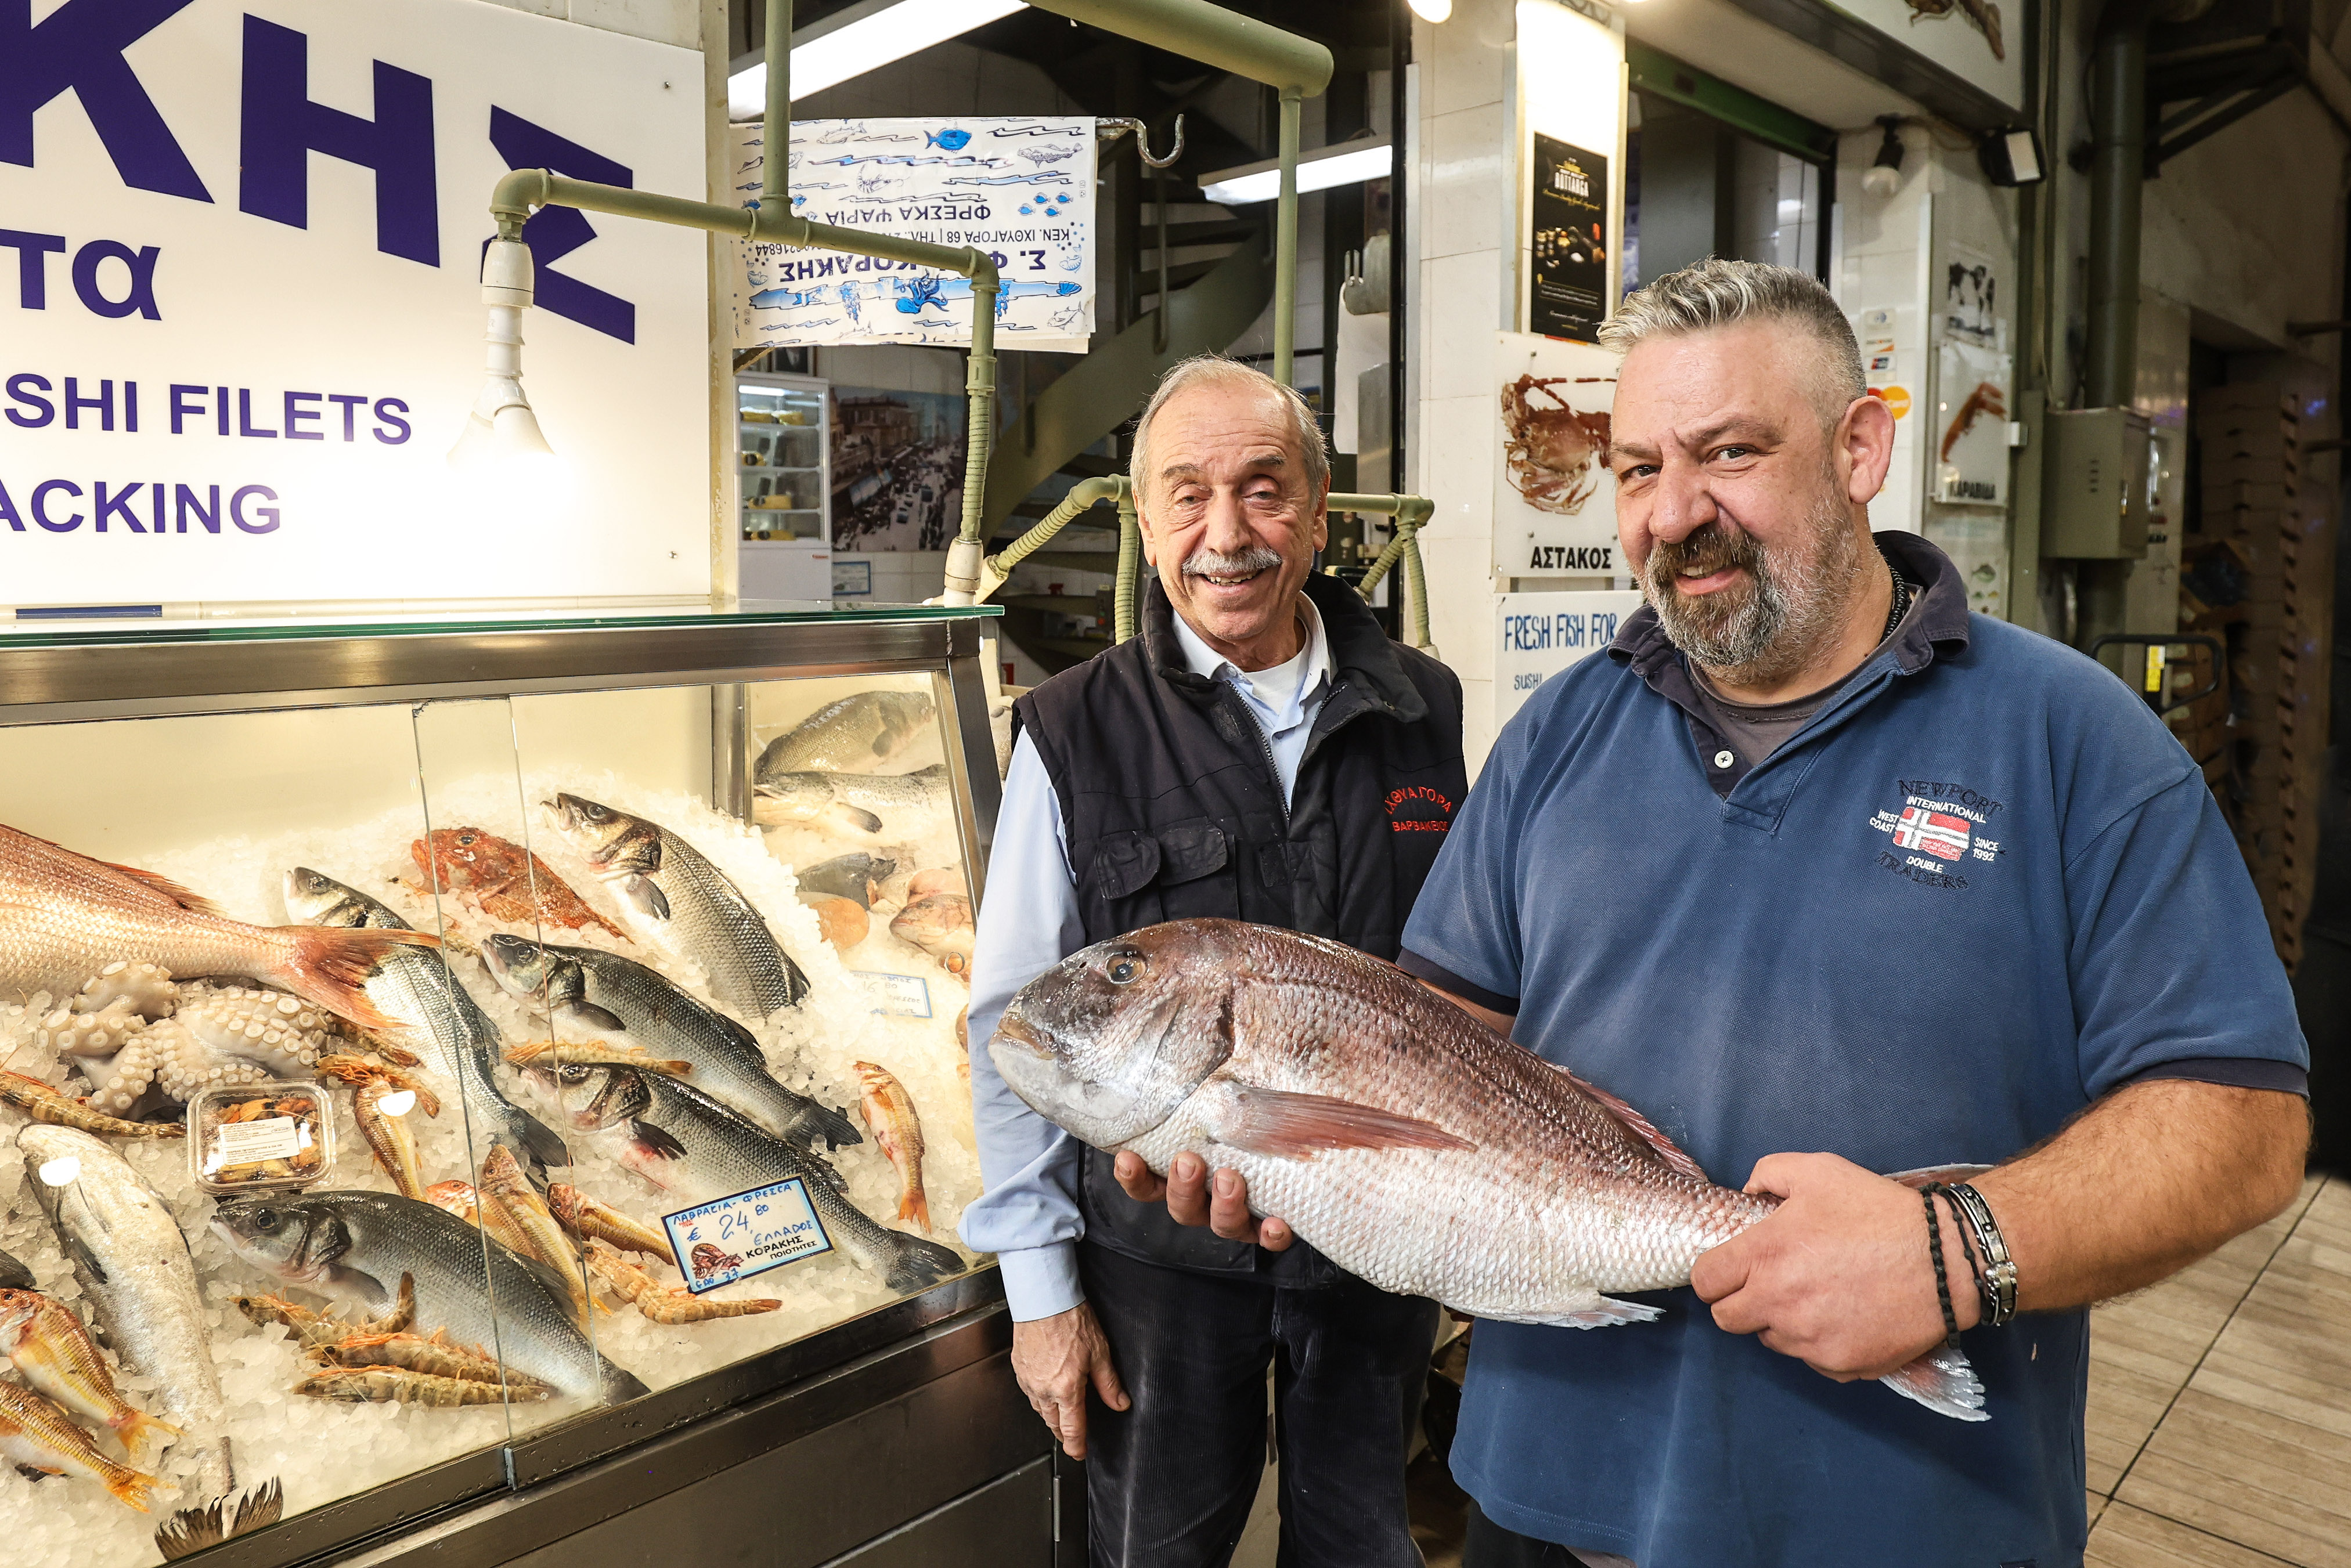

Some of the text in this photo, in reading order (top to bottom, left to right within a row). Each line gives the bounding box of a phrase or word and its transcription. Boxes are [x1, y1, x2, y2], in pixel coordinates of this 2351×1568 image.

[825, 204, 991, 226] ΦΡΕΣΚΑ ΨΑΡΙΑ
[947, 231, 961, 243] 68
[964, 229, 1036, 243] ΙΧΘΥΑΓΟΡΑ
[1040, 229, 1069, 241] ΚΕΝ.
[1020, 250, 1046, 270] Σ.
[170, 383, 412, 445] FILETS
[1530, 546, 1612, 569] ΑΣΤΑΚΟΣ
[1504, 613, 1617, 652] FRESH FISH FOR
[1514, 673, 1542, 691] SUSHI
[1384, 786, 1452, 815] ΙΧΘΥΑΓΟΡΑ
[1897, 780, 2003, 817] NEWPORT
[1877, 809, 1899, 823] WEST
[1906, 795, 1986, 823] INTERNATIONAL
[1869, 817, 1895, 833] COAST
[1974, 837, 1999, 851] SINCE
[1973, 848, 1995, 861] 1992
[1876, 851, 1968, 889] TRADERS
[1906, 856, 1944, 873] DOUBLE
[755, 1205, 769, 1216] 80
[754, 1220, 813, 1246] ΕΛΛΑΔΟΣ
[746, 1235, 803, 1259] ΚΟΡΑΚΗΣ
[770, 1241, 817, 1260] ΠΟΙΟΤΗΤΕΣ
